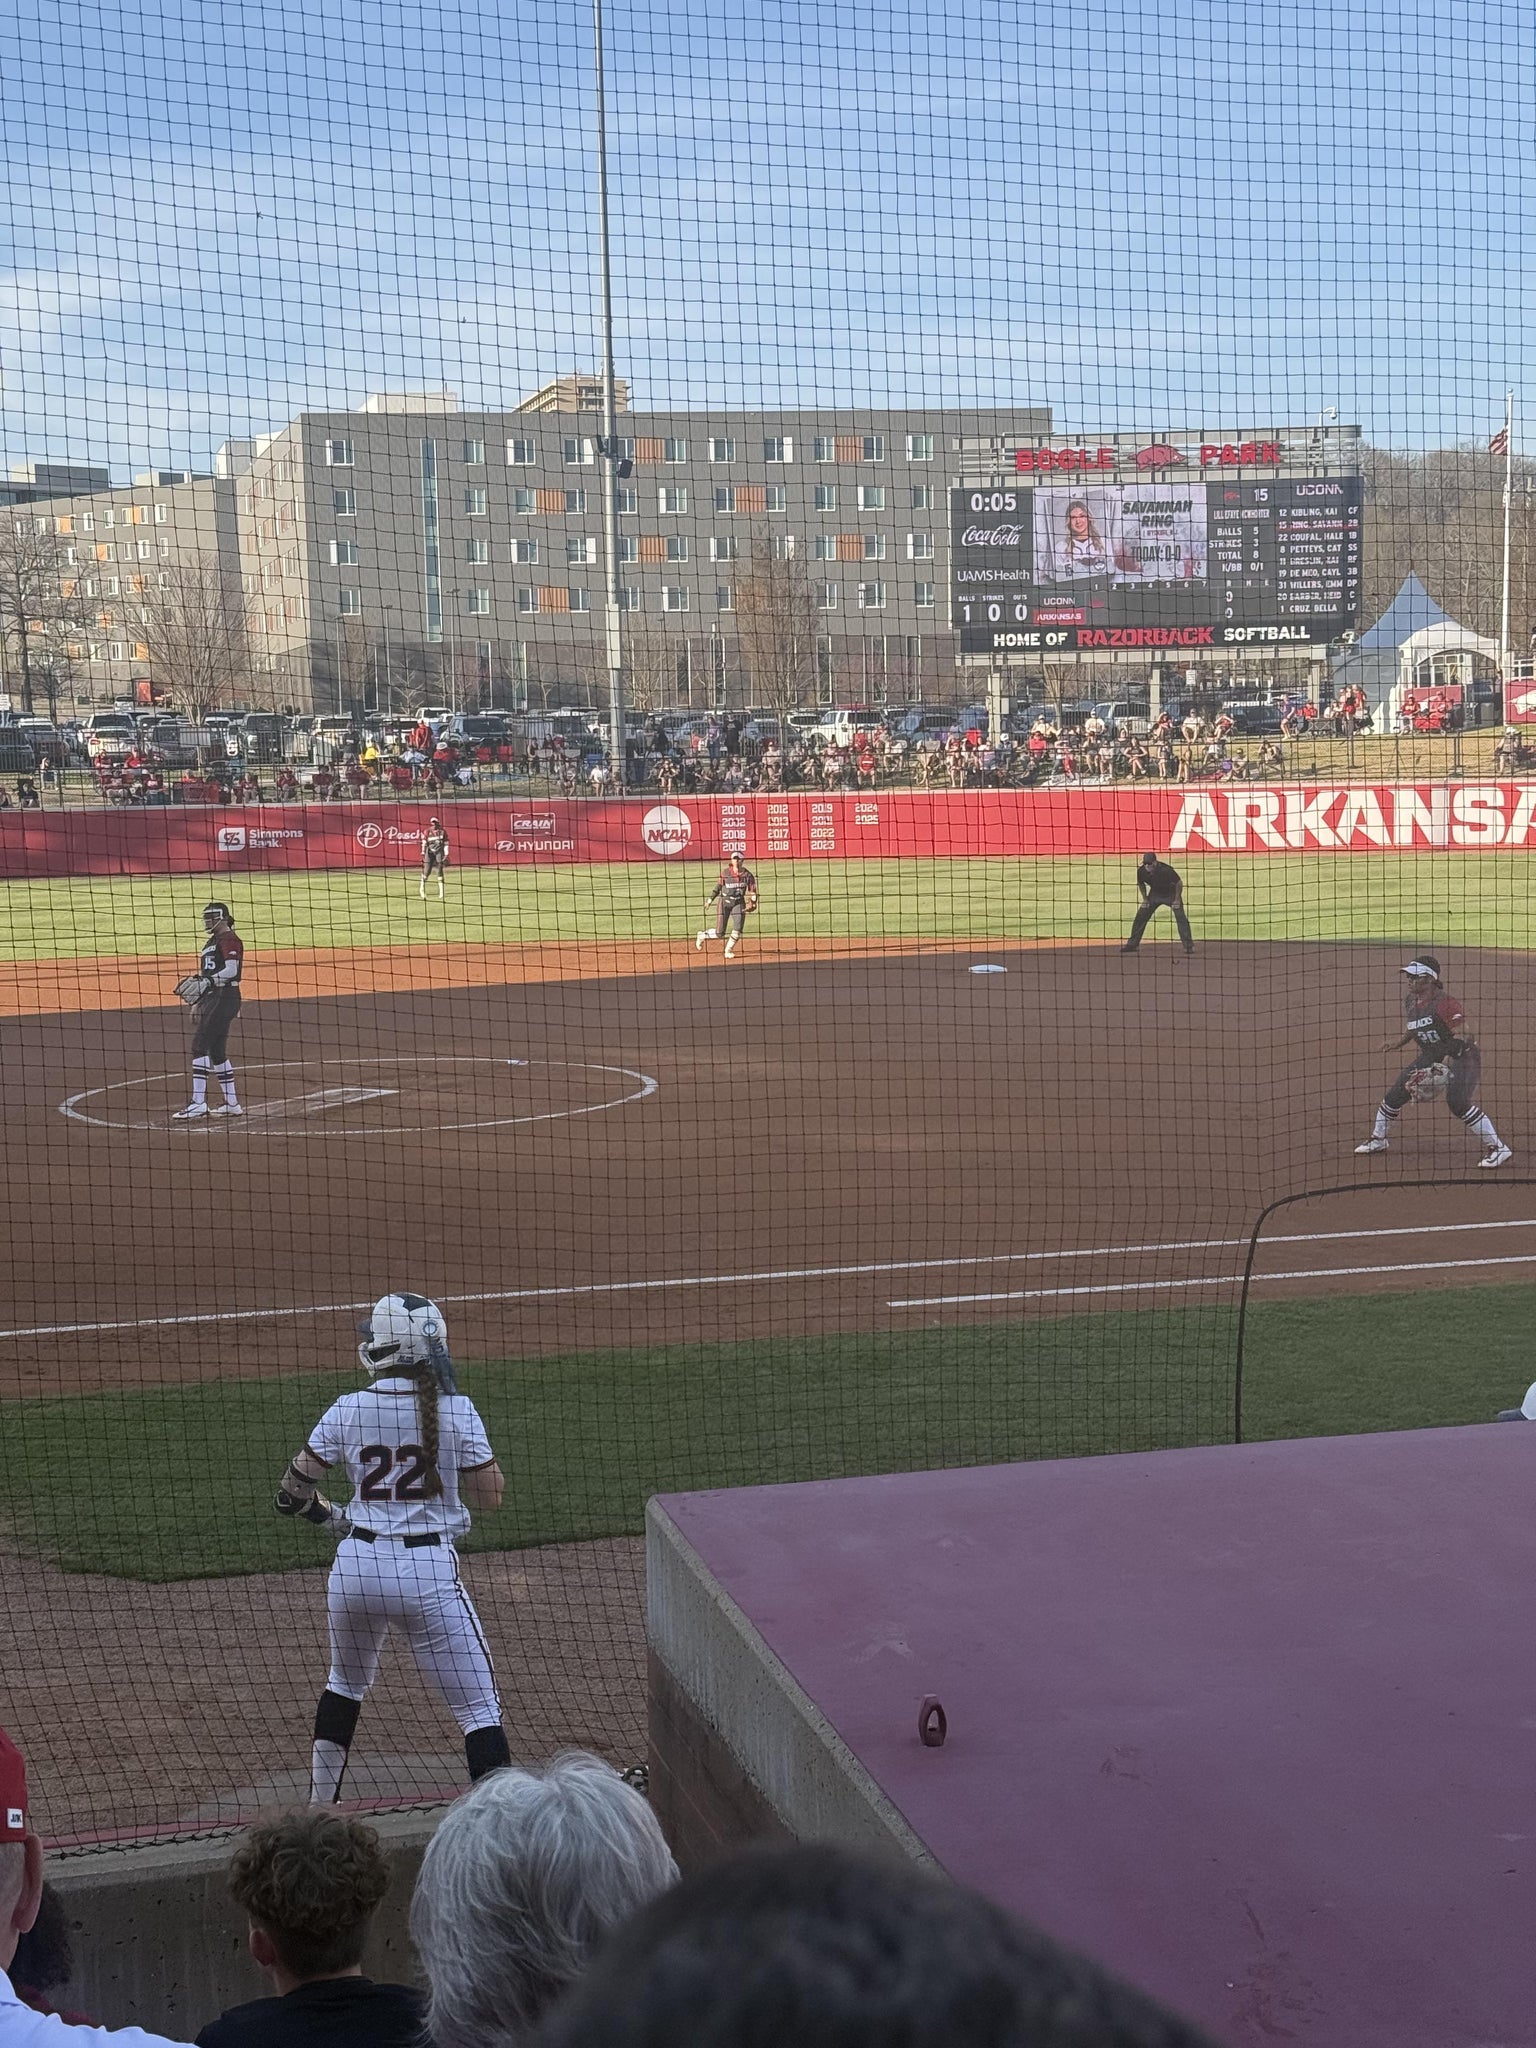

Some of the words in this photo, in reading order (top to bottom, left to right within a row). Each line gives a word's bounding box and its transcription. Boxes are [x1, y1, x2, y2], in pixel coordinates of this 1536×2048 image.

[1016, 448, 1113, 470] BOGLE
[1200, 442, 1280, 465] PARK
[1254, 488, 1268, 501] 15
[1296, 484, 1343, 495] UCONN
[971, 493, 1016, 511] 0:05
[1122, 500, 1192, 514] SAVANNAH
[1141, 515, 1173, 527] RING
[961, 524, 1024, 546] Coca-Cola
[1217, 527, 1242, 536] BALLS
[1253, 527, 1259, 535] 5
[1278, 533, 1288, 541] 22
[1209, 539, 1242, 548] STRIKES
[1254, 539, 1259, 547] 3
[1327, 544, 1341, 552] CAT
[1131, 545, 1164, 562] TODAY:
[1217, 551, 1242, 560] TOTAL
[1253, 551, 1258, 559] 8
[1222, 563, 1242, 572] K/BB
[1250, 562, 1263, 571] 0/1
[1322, 568, 1341, 576] CAYL
[957, 570, 993, 581] UAMS
[994, 570, 1030, 581] Health
[1278, 581, 1287, 589] 31
[1347, 579, 1357, 587] DP
[982, 594, 1004, 602] STRIKES
[1043, 597, 1075, 605] UCONN
[963, 604, 970, 622] 1
[988, 604, 1000, 621] 0
[1015, 603, 1027, 621] 0
[1037, 611, 1082, 621] ARKANSAS
[993, 633, 1040, 646] HOME
[1045, 632, 1068, 645] OF
[1077, 626, 1215, 646] RAZORBACK
[1224, 626, 1310, 641] SOFTBALL
[722, 805, 746, 815] 2000
[768, 804, 789, 814] 2012
[811, 803, 833, 813] 2019
[855, 803, 878, 812] 2024
[513, 819, 553, 829] CRAIN
[768, 817, 789, 826] 2013
[855, 815, 879, 824] 2025
[250, 829, 303, 839] Simmons
[384, 826, 425, 840] Pasch
[648, 829, 689, 843] NCAA
[722, 830, 746, 839] 2008
[768, 829, 789, 838] 2017
[811, 828, 834, 838] 2022
[518, 840, 573, 850] HYUNDAI
[722, 842, 746, 851] 2009
[768, 841, 789, 850] 2018
[811, 840, 834, 850] 2023
[204, 955, 216, 969] 15
[359, 1444, 433, 1501] 22
